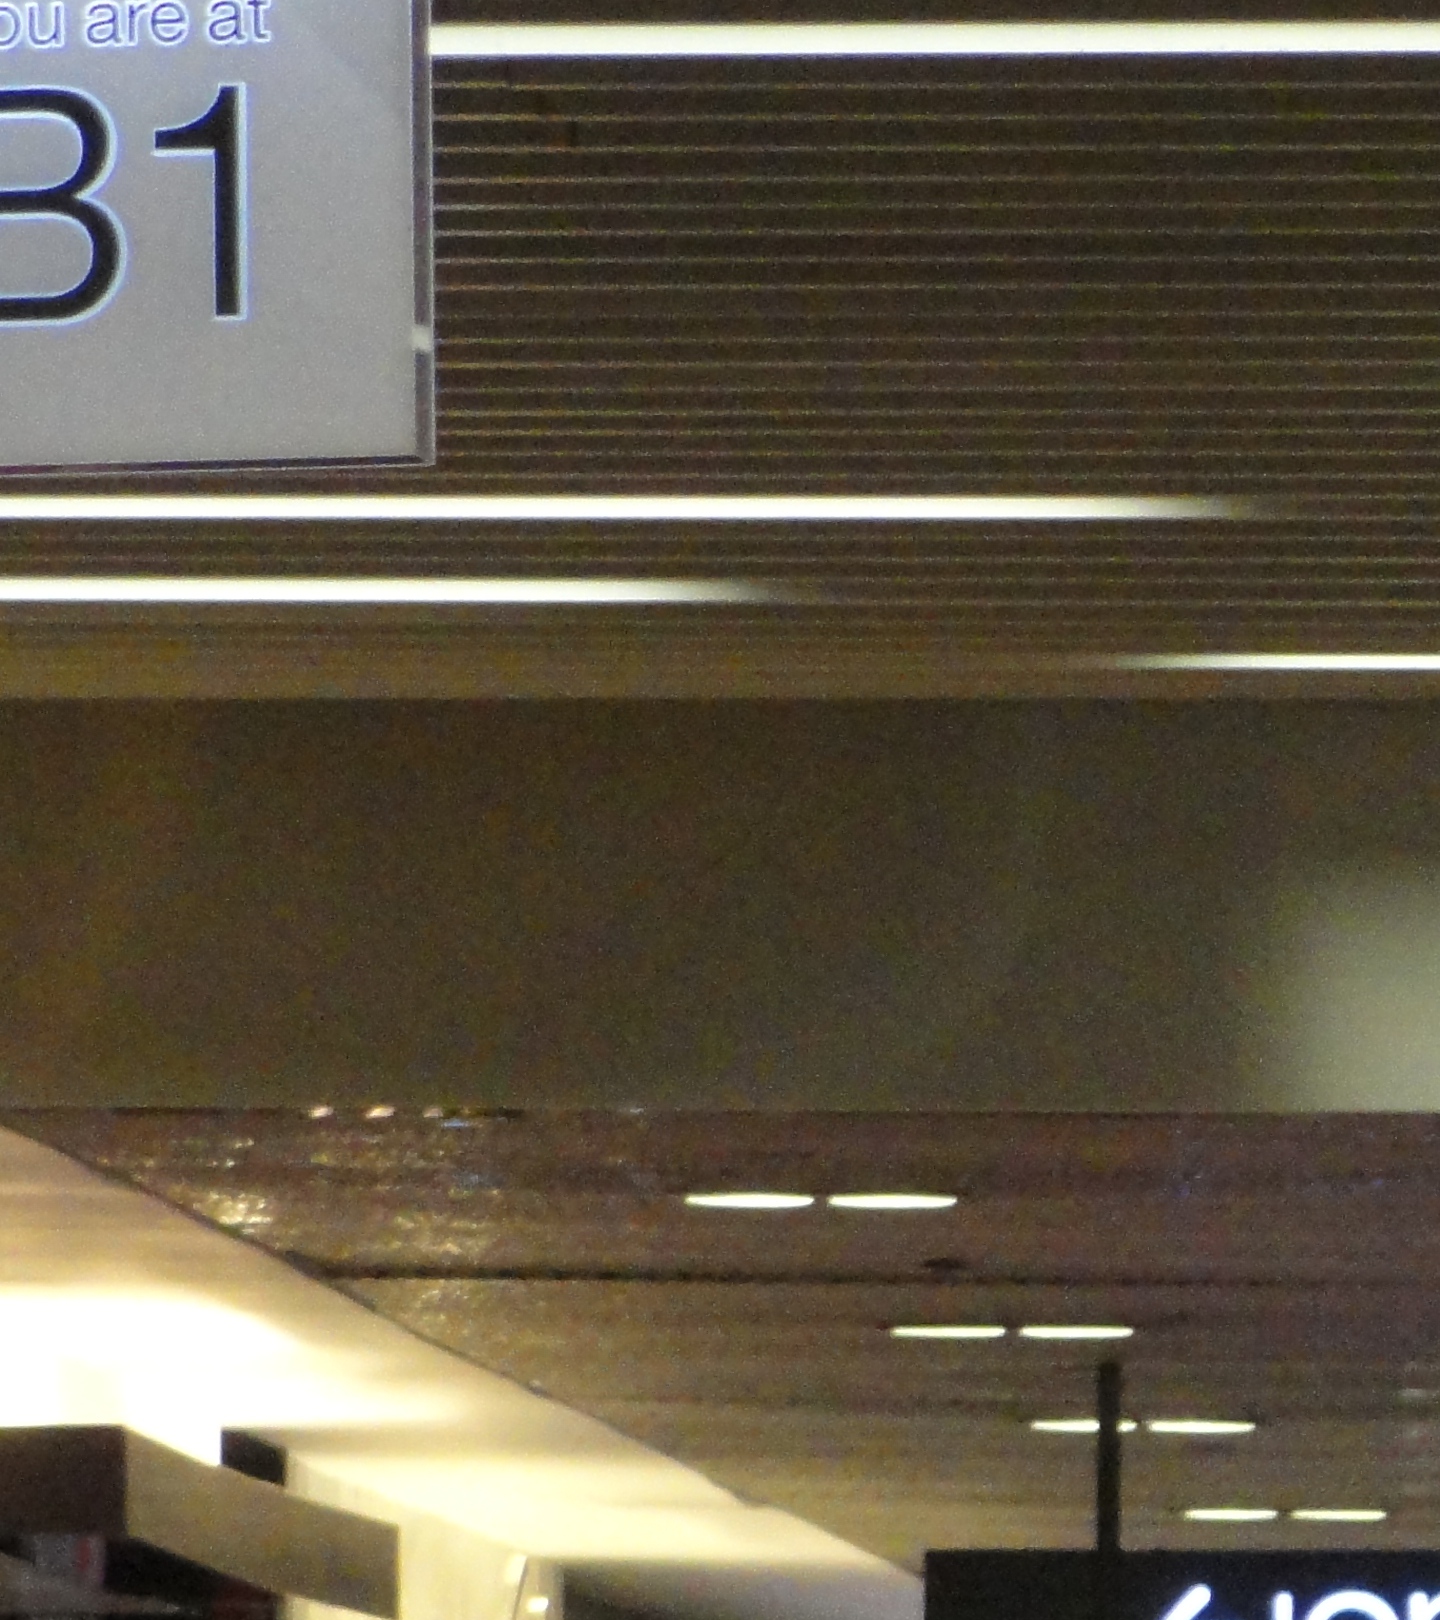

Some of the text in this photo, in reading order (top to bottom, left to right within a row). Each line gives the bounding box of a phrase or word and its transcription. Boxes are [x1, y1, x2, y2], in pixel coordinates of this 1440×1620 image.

[0, 0, 272, 48] ou are at
[0, 84, 247, 324] B1
